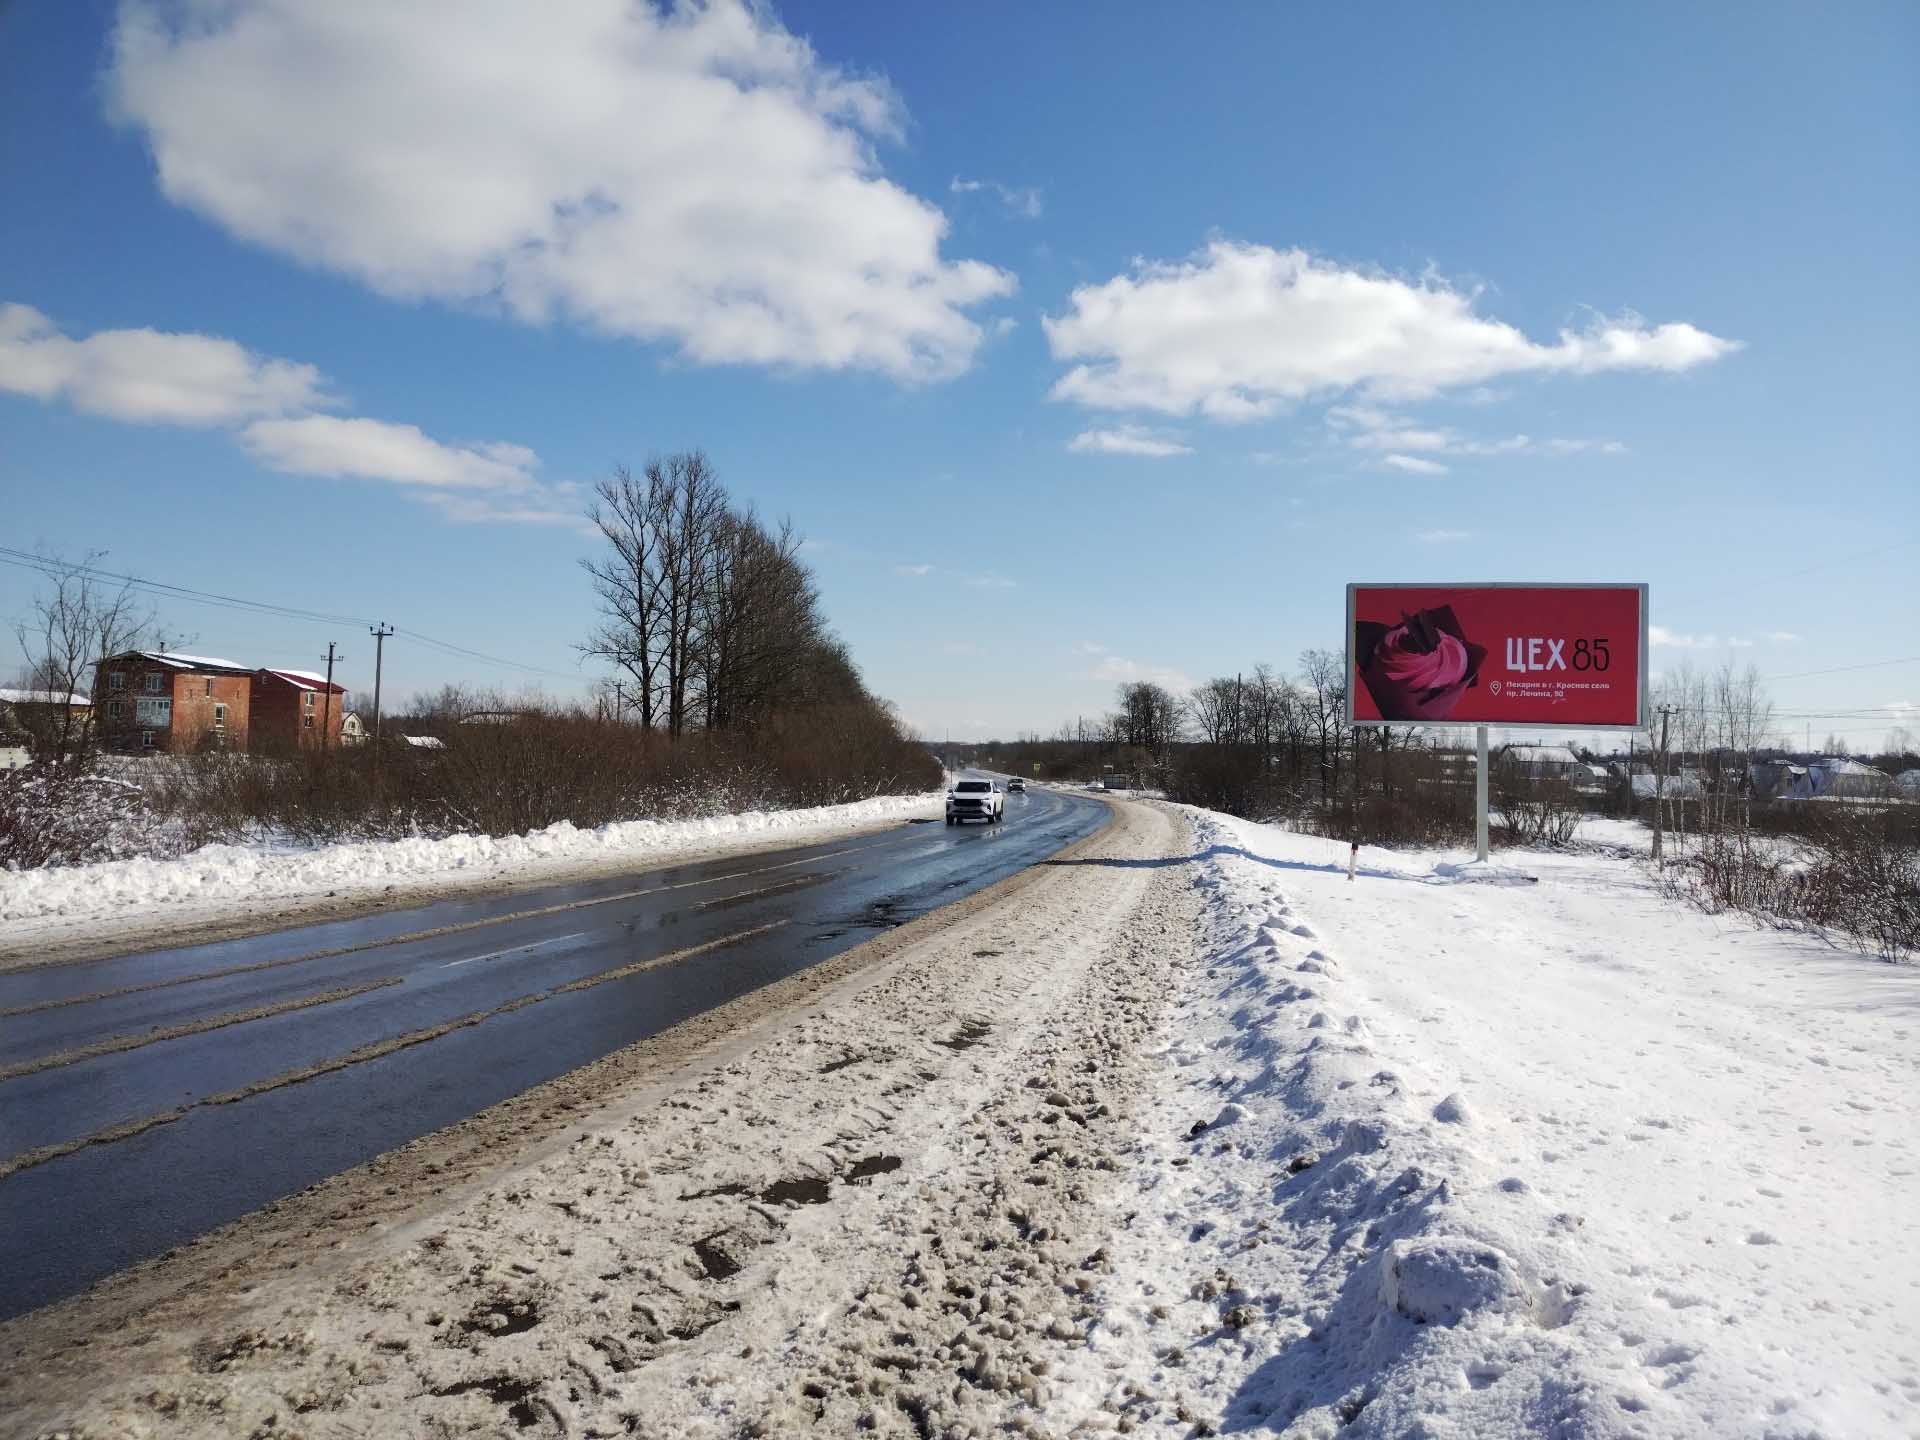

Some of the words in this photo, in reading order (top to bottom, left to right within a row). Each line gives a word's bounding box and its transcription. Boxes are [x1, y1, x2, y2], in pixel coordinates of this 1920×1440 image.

[1506, 637, 1567, 673] ЦЕХ
[1572, 638, 1610, 672] 85
[1506, 681, 1541, 689] Пекарня
[1556, 681, 1590, 690] Красное
